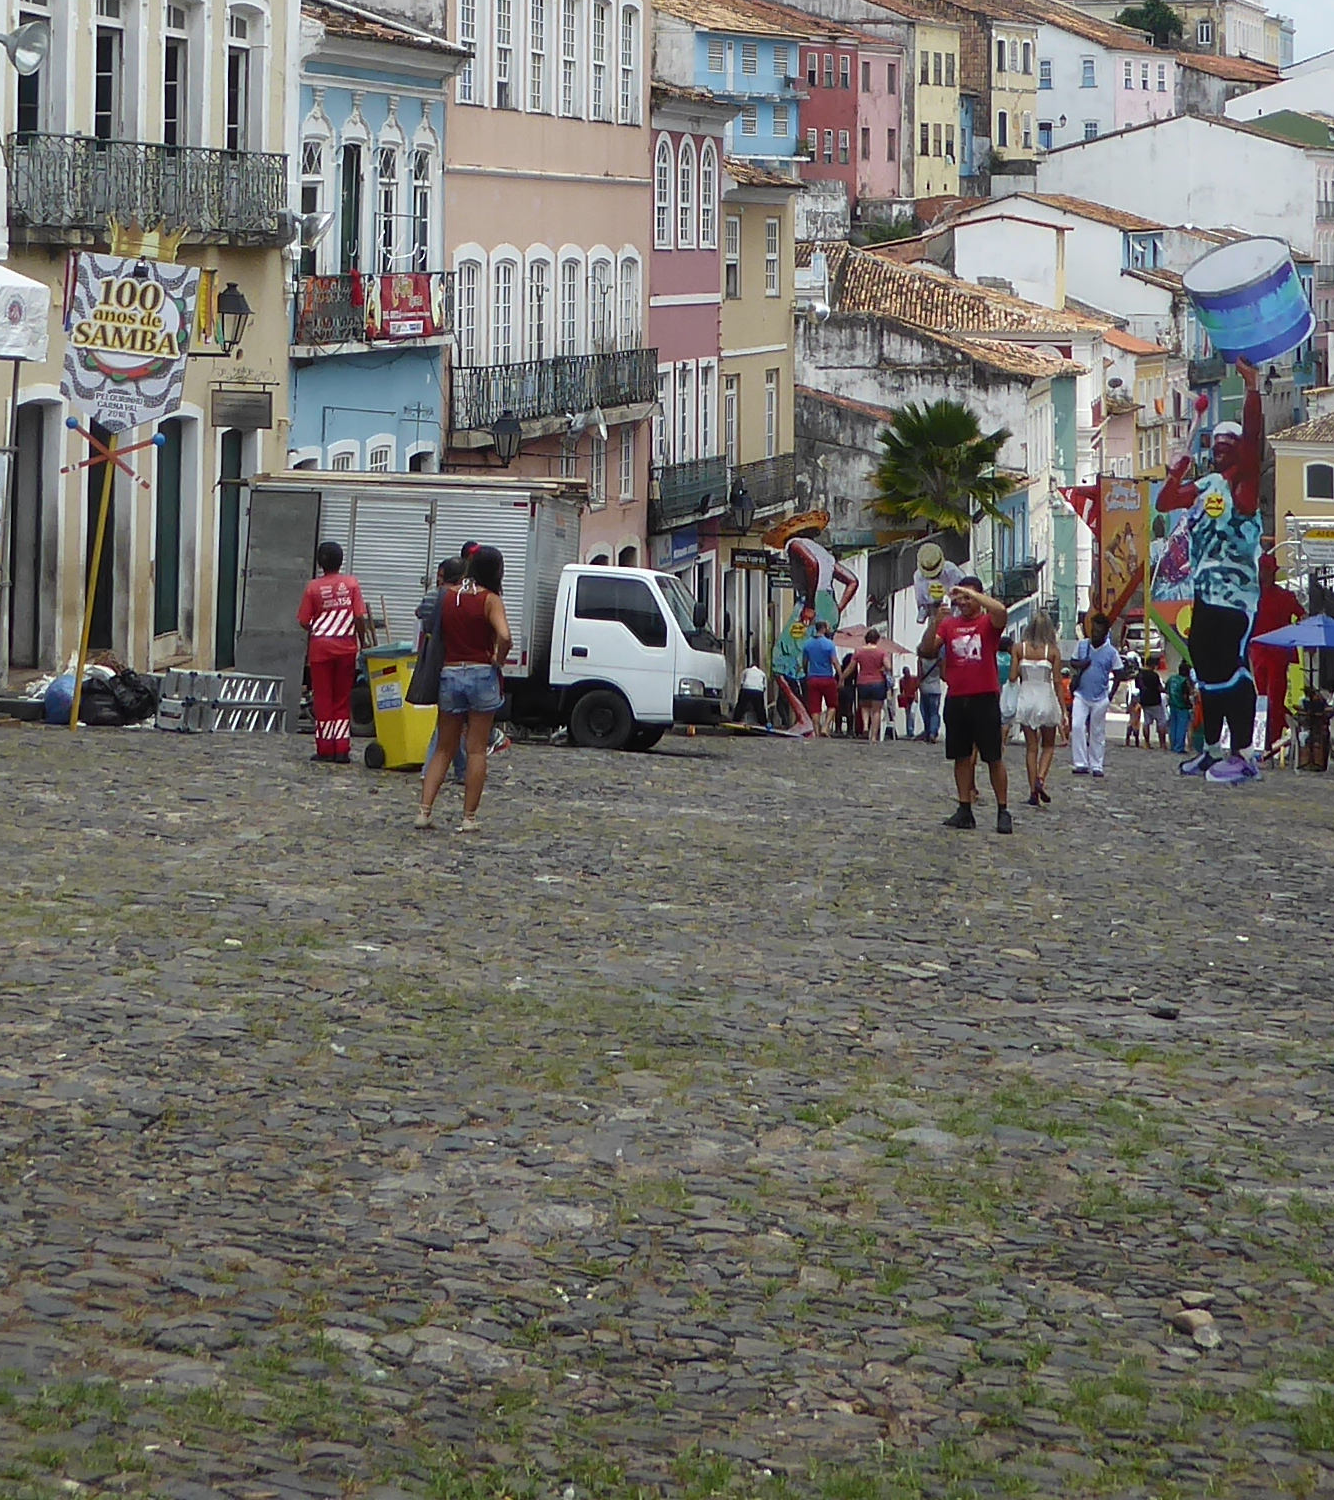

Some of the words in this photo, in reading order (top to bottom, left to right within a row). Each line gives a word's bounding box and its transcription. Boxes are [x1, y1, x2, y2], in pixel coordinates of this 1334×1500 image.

[96, 279, 163, 311] 100
[93, 309, 136, 324] anos
[140, 310, 163, 328] de
[73, 321, 178, 356] SAMBA
